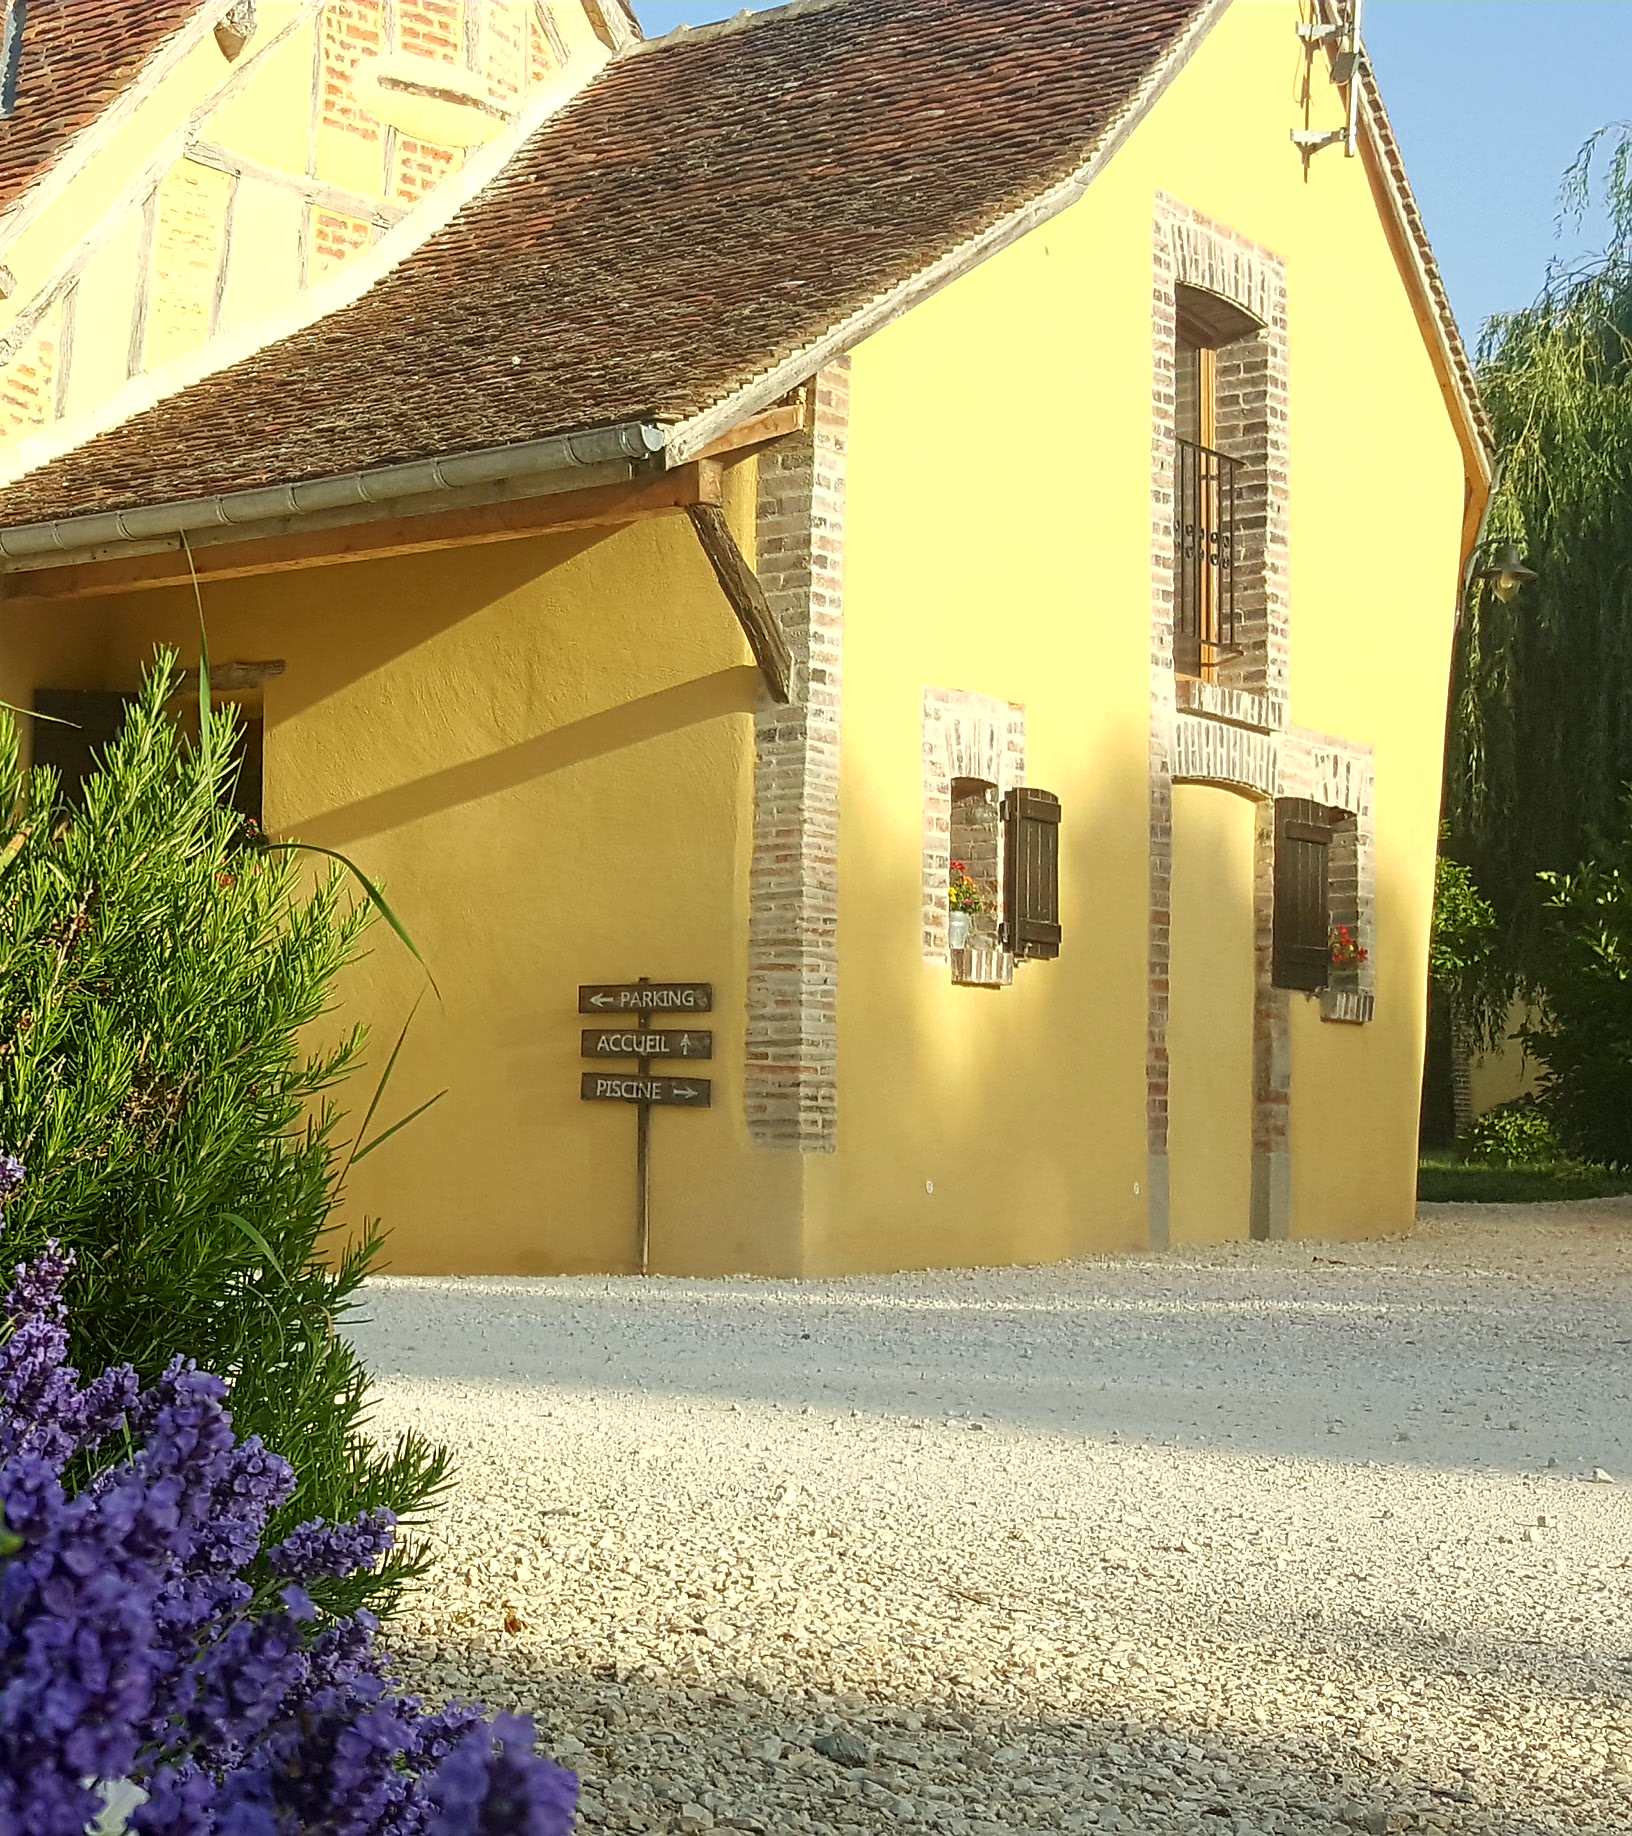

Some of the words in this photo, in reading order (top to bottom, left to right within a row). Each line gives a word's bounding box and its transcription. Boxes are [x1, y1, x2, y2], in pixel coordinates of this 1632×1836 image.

[620, 990, 695, 1008] PARKING
[597, 1034, 671, 1055] ACCUEIL
[596, 1079, 662, 1100] PISCINE
